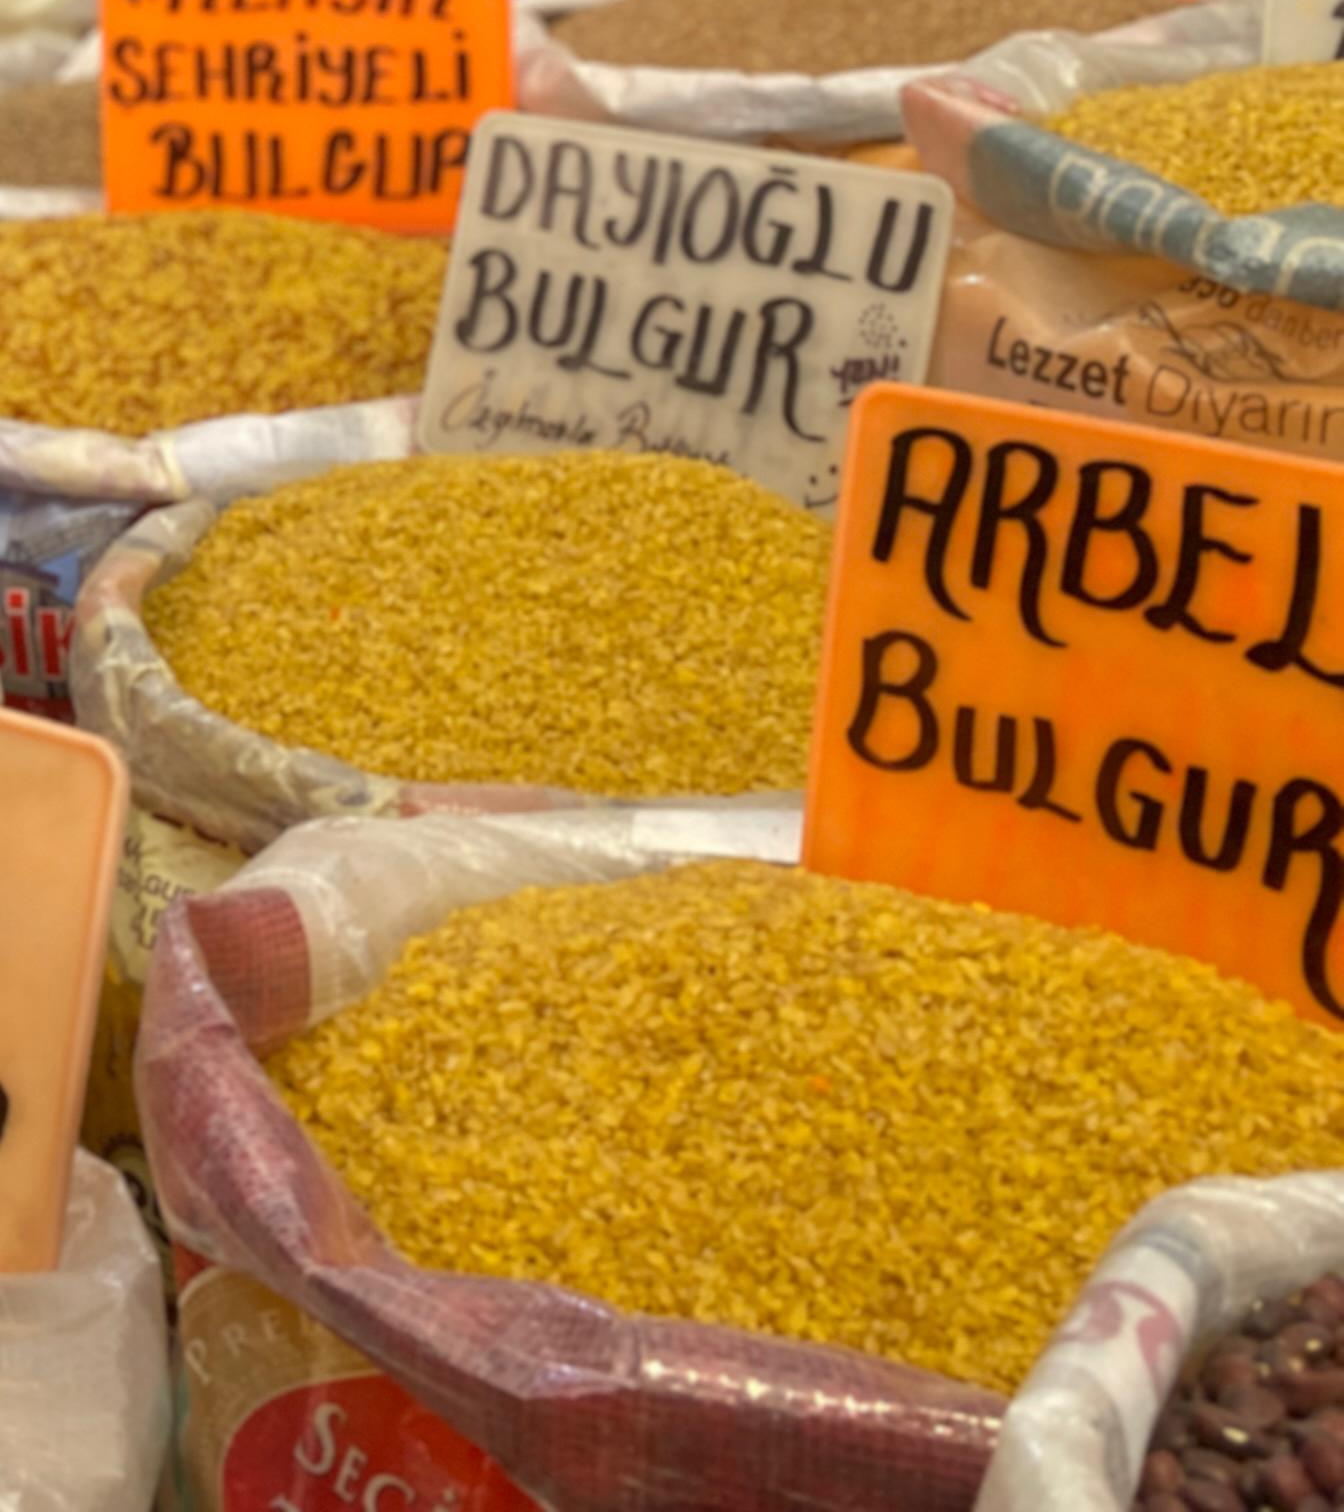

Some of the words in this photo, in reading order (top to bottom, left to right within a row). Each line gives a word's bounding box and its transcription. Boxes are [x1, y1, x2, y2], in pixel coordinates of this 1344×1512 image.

[477, 134, 936, 294] DAYIOĞLU
[453, 246, 828, 444] BULGUR
[985, 315, 1132, 407] Lezzet
[871, 426, 1344, 688] ARBEL
